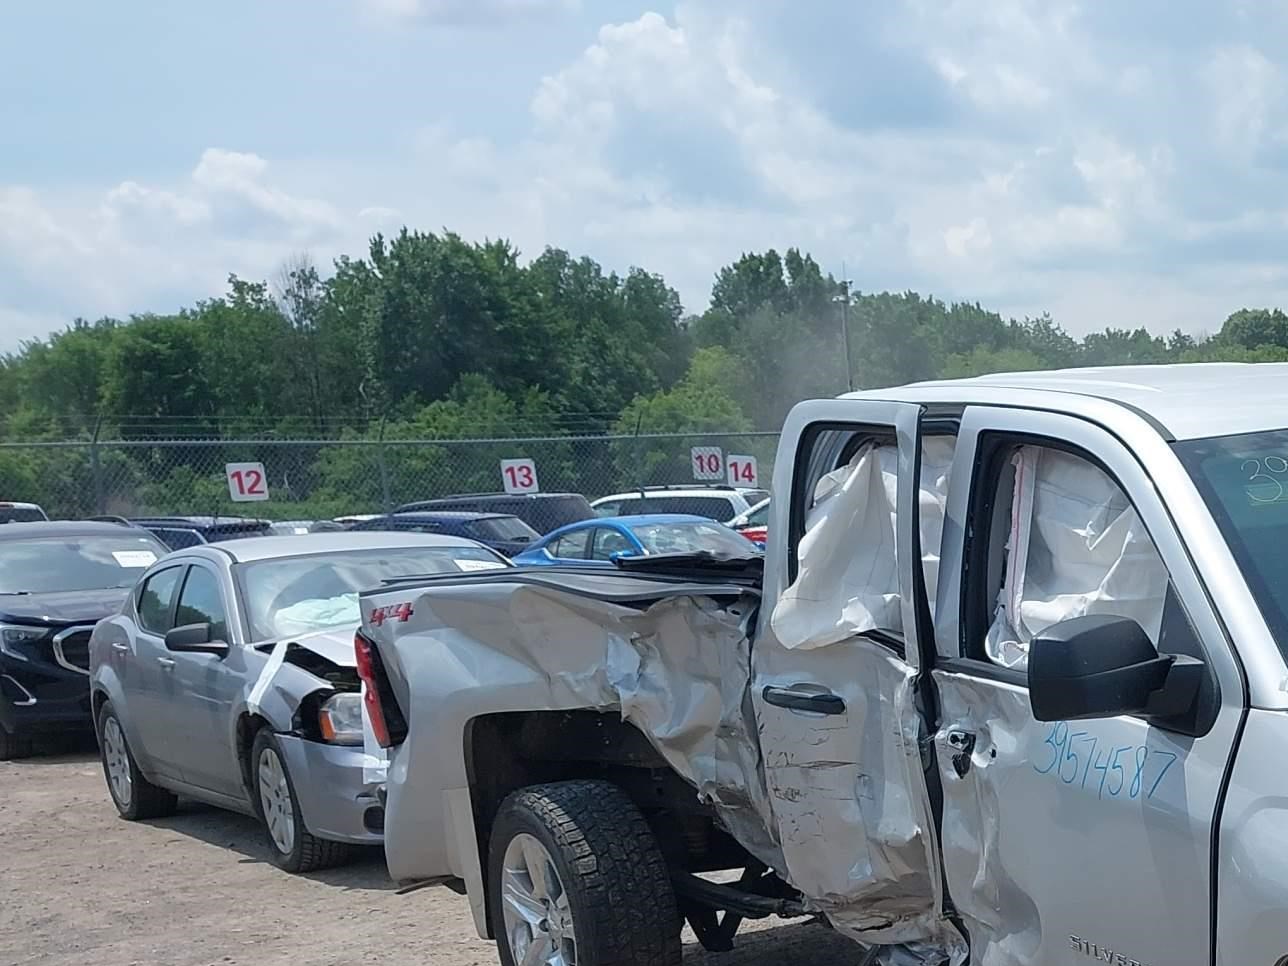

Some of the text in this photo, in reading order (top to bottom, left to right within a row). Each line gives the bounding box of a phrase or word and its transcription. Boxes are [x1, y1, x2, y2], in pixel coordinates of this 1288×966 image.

[695, 454, 720, 473] 10
[729, 461, 755, 483] 14
[230, 470, 265, 495] 12
[505, 465, 534, 488] 13
[1033, 720, 1178, 800] 39574587
